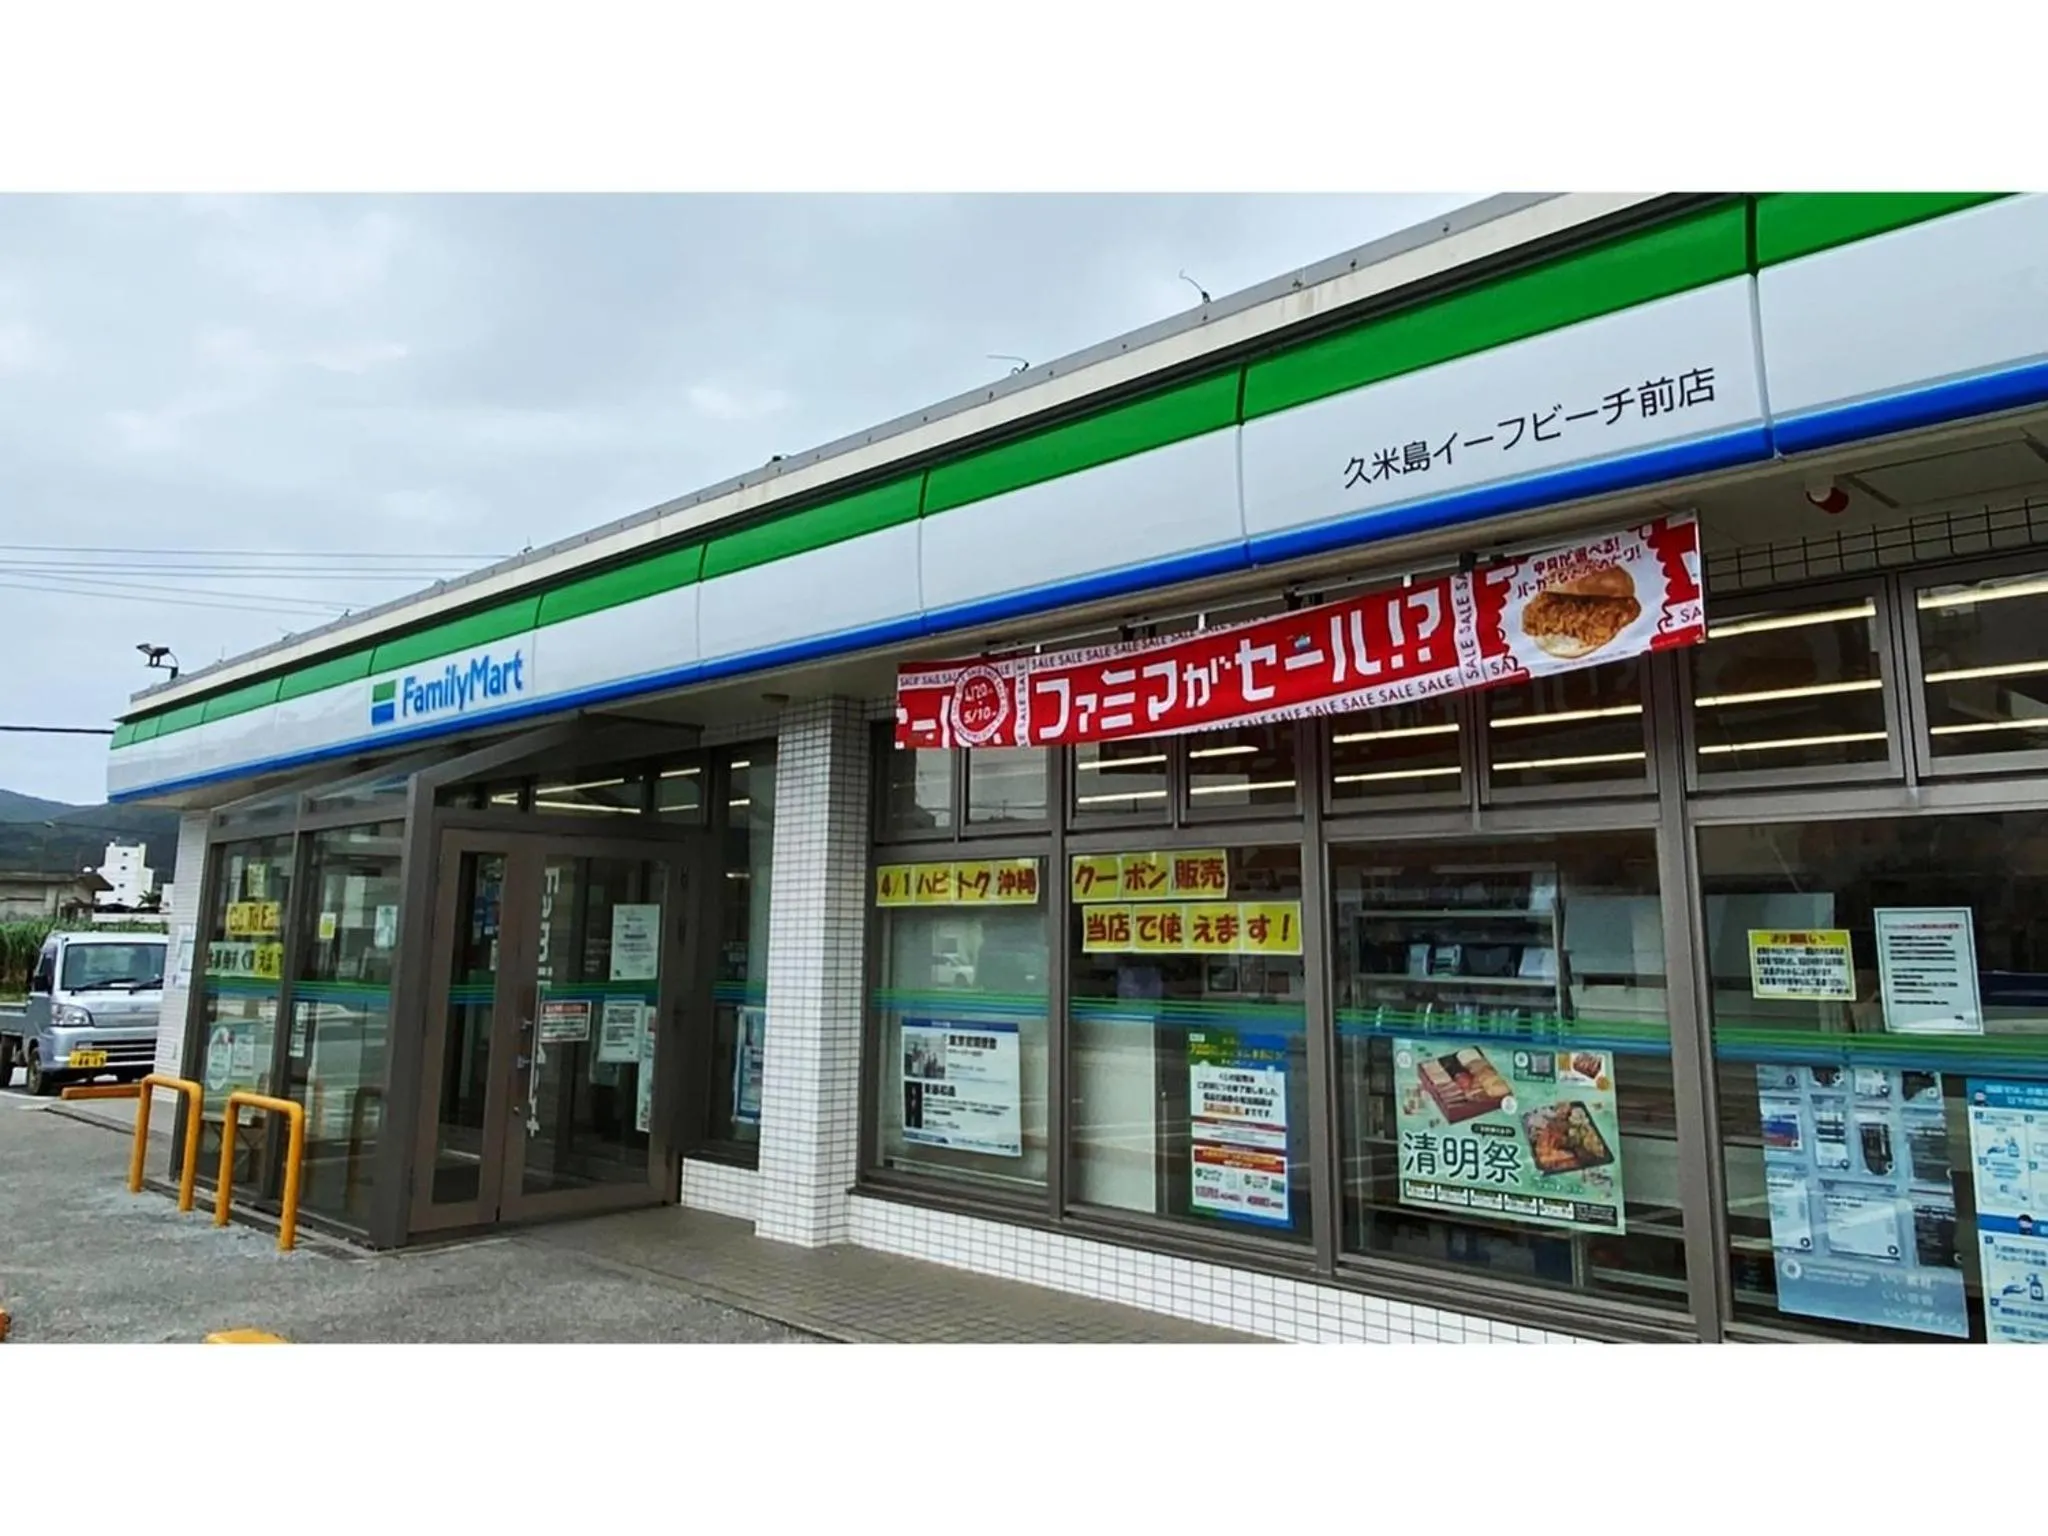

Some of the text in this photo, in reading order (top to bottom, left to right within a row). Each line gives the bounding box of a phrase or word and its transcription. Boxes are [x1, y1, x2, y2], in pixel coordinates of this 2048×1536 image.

[1343, 366, 1715, 489] 久米島イーフビーチ前店
[1456, 595, 1472, 634] SALE
[1032, 654, 1056, 669] SALE
[1059, 650, 1083, 666] SALE
[1086, 645, 1110, 661] SALE
[1035, 587, 1441, 740] ファミマがセール!?
[1460, 639, 1479, 679] SALE
[401, 650, 524, 718] FamilyMart
[1342, 692, 1377, 710] SALE
[1379, 684, 1414, 702] SALE
[1418, 676, 1455, 694] SALE
[1403, 1131, 1522, 1184] 清明祭
